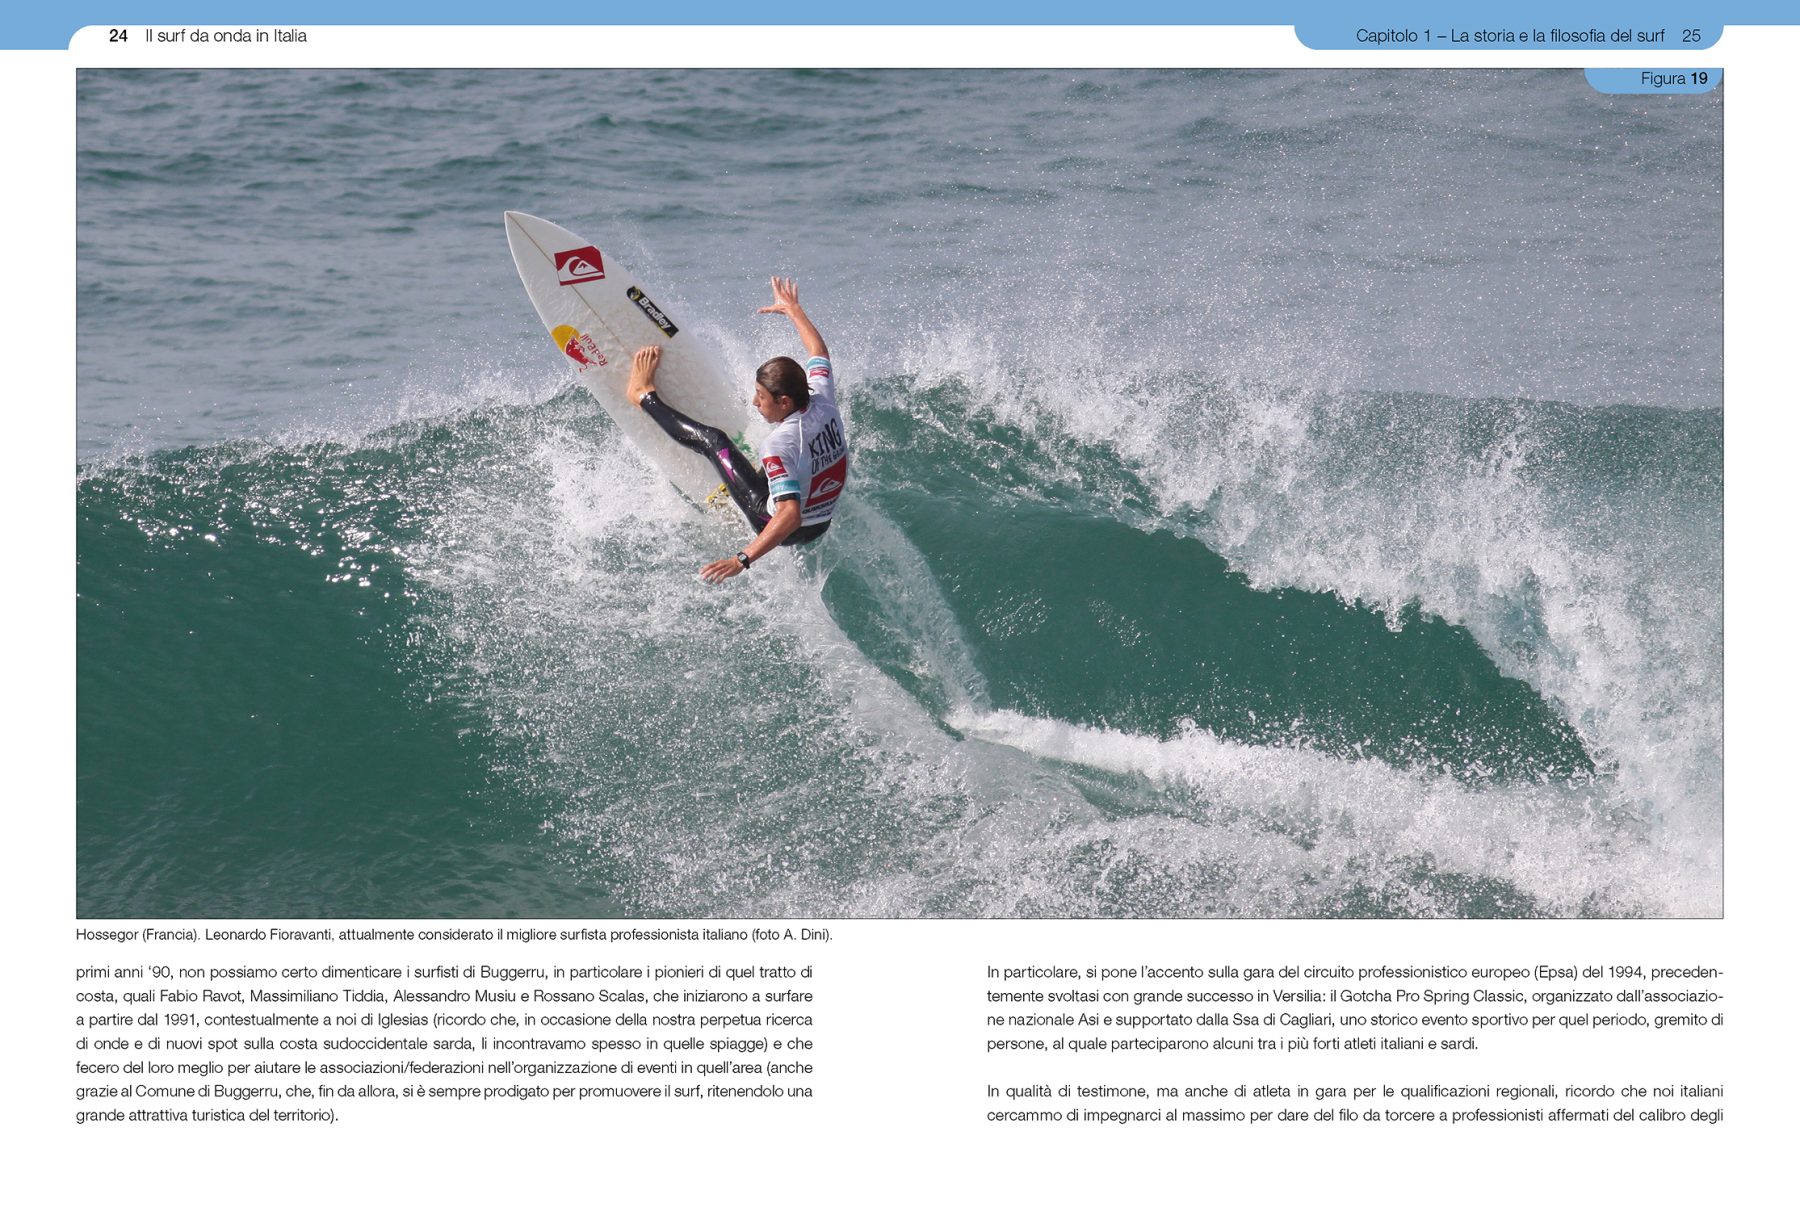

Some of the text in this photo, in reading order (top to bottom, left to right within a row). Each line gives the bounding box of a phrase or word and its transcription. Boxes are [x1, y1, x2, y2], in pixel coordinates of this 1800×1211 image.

[110, 28, 307, 43] 24 Il surf da onda in Italia
[1357, 29, 1417, 45] Capitolo
[1423, 28, 1430, 43] 1
[1452, 29, 1469, 42] La
[1474, 29, 1515, 42] storia
[1519, 32, 1528, 42] e
[1534, 29, 1545, 42] la
[1551, 29, 1605, 42] filosofia
[1611, 29, 1631, 42] del
[1637, 29, 1665, 42] surf
[1683, 29, 1701, 42] 25
[1642, 72, 1707, 88] Figura 19
[638, 296, 672, 330] Bradley
[808, 418, 842, 458] KING
[77, 928, 832, 943] Hossegor (Francia). Leonardo Fioravanti, attualmente considerato il migliore surfista professionista italiano (foto A. Dini).
[77, 965, 109, 981] primi
[114, 966, 143, 978] anni
[180, 969, 205, 978] non
[210, 965, 277, 981] possiamo
[282, 966, 317, 978] certo
[322, 965, 402, 978] dimenticare
[406, 965, 410, 979] i
[414, 965, 458, 978] surfisti
[463, 966, 475, 978] di
[481, 965, 548, 981] Buggerru,
[554, 966, 564, 978] in
[570, 965, 642, 981] particolare
[646, 965, 650, 979] i
[655, 965, 703, 981] pionieri
[709, 965, 720, 978] di
[726, 966, 754, 981] quel
[759, 966, 796, 978] tratto
[801, 966, 812, 978] di
[988, 965, 1723, 981] In particolare, si pone l’accento sulla gara del circuito professionistico europeo (Epsa) del 1994, preceden-
[76, 1013, 812, 1029] a partire dal 1991, contestualmente a noi di Iglesias (ricordo che, in occasione della nostra perpetua ricerca
[988, 1013, 1723, 1029] ne nazionale Asi e supportato dalla Ssa di Cagliari, uno storico evento sportivo per quel periodo, gremito di
[76, 1061, 813, 1077] fecero del loro meglio per aiutare le associazioni/federazioni nell’organizzazione di eventi in quell’area (anche
[988, 1085, 1723, 1100] In qualità di testimone, ma anche di atleta in gara per le qualificazioni regionali, ricordo che noi italiani
[76, 1109, 338, 1124] grande attrattiva turistica del territorio).
